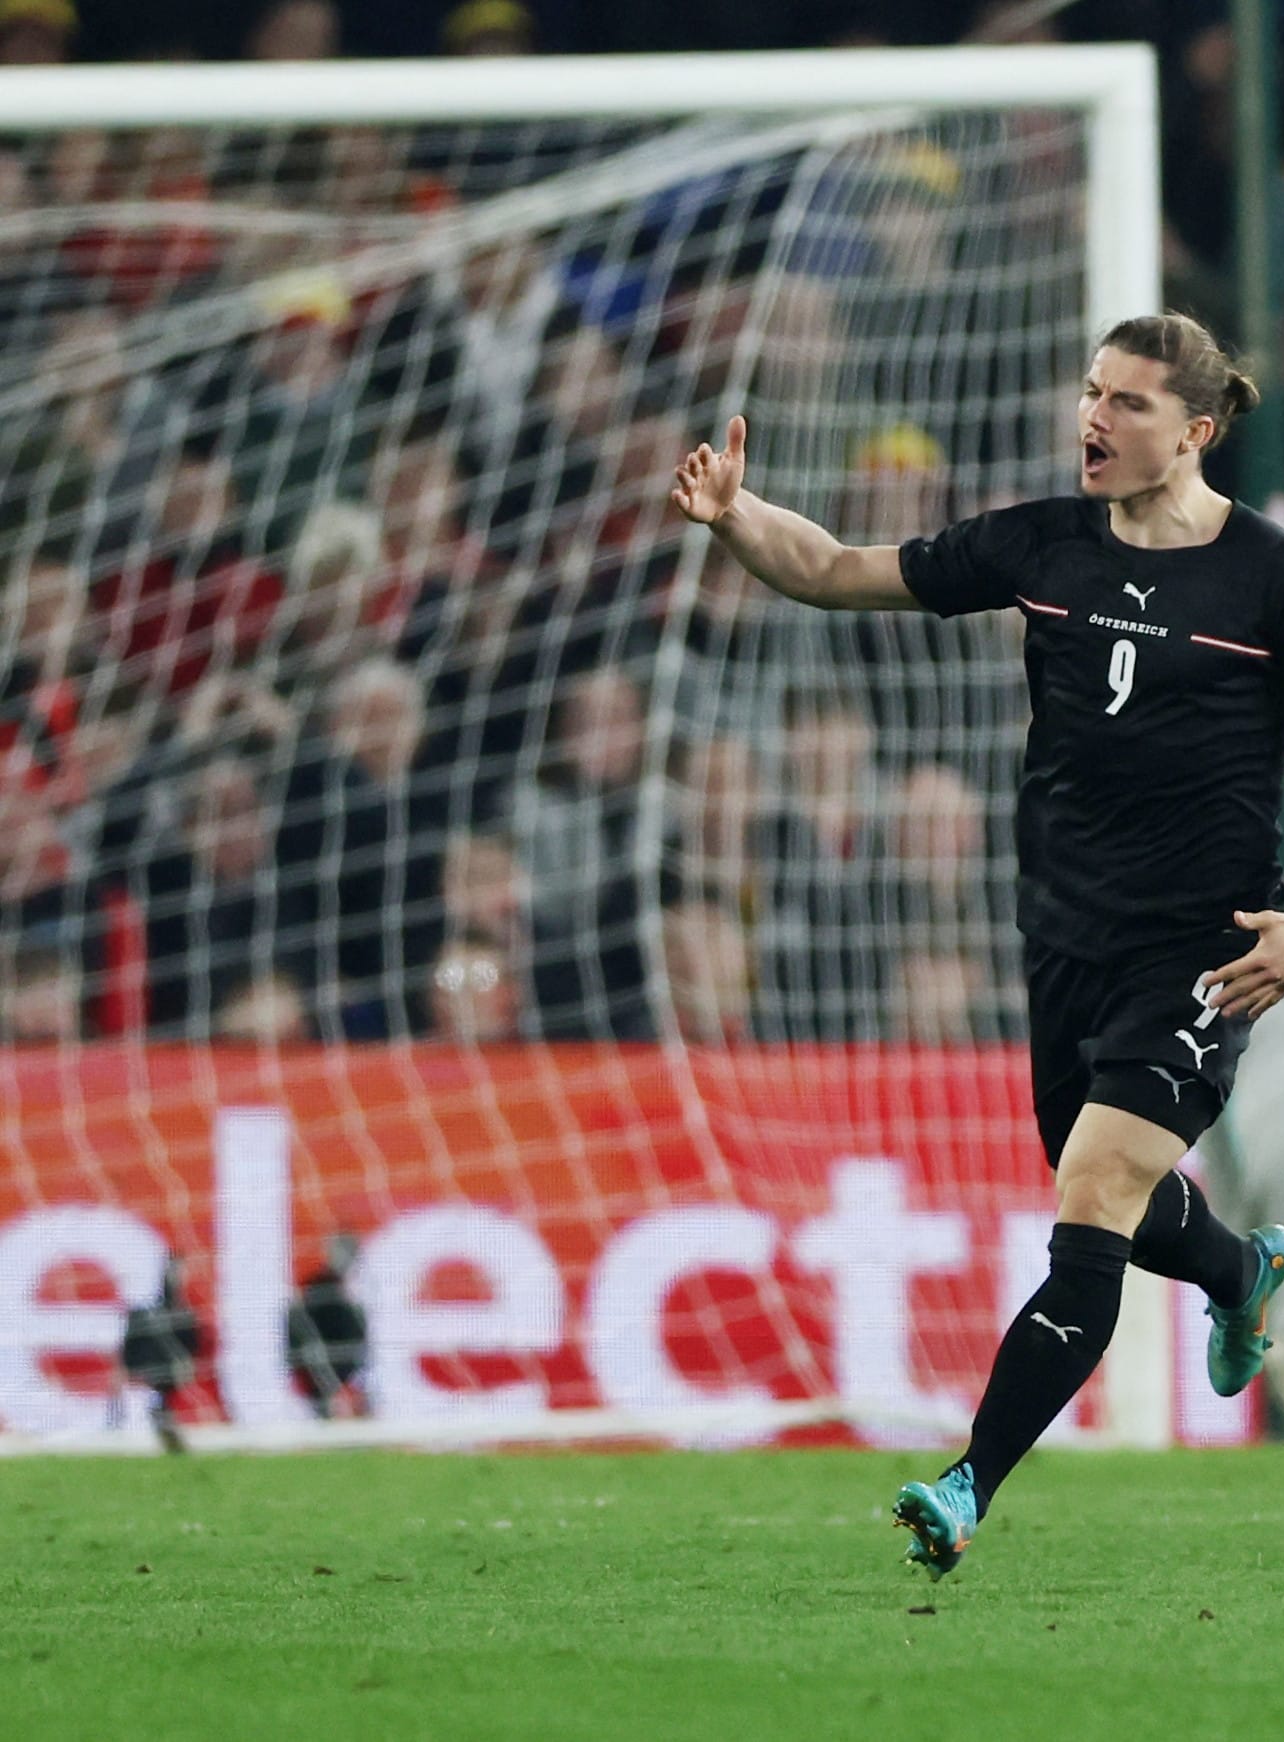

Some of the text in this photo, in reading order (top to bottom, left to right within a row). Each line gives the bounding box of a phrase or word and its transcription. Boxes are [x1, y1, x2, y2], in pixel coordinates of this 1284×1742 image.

[1088, 612, 1169, 638] ÖSTERREICH
[1104, 638, 1137, 716] 9
[1191, 969, 1225, 1030] 9
